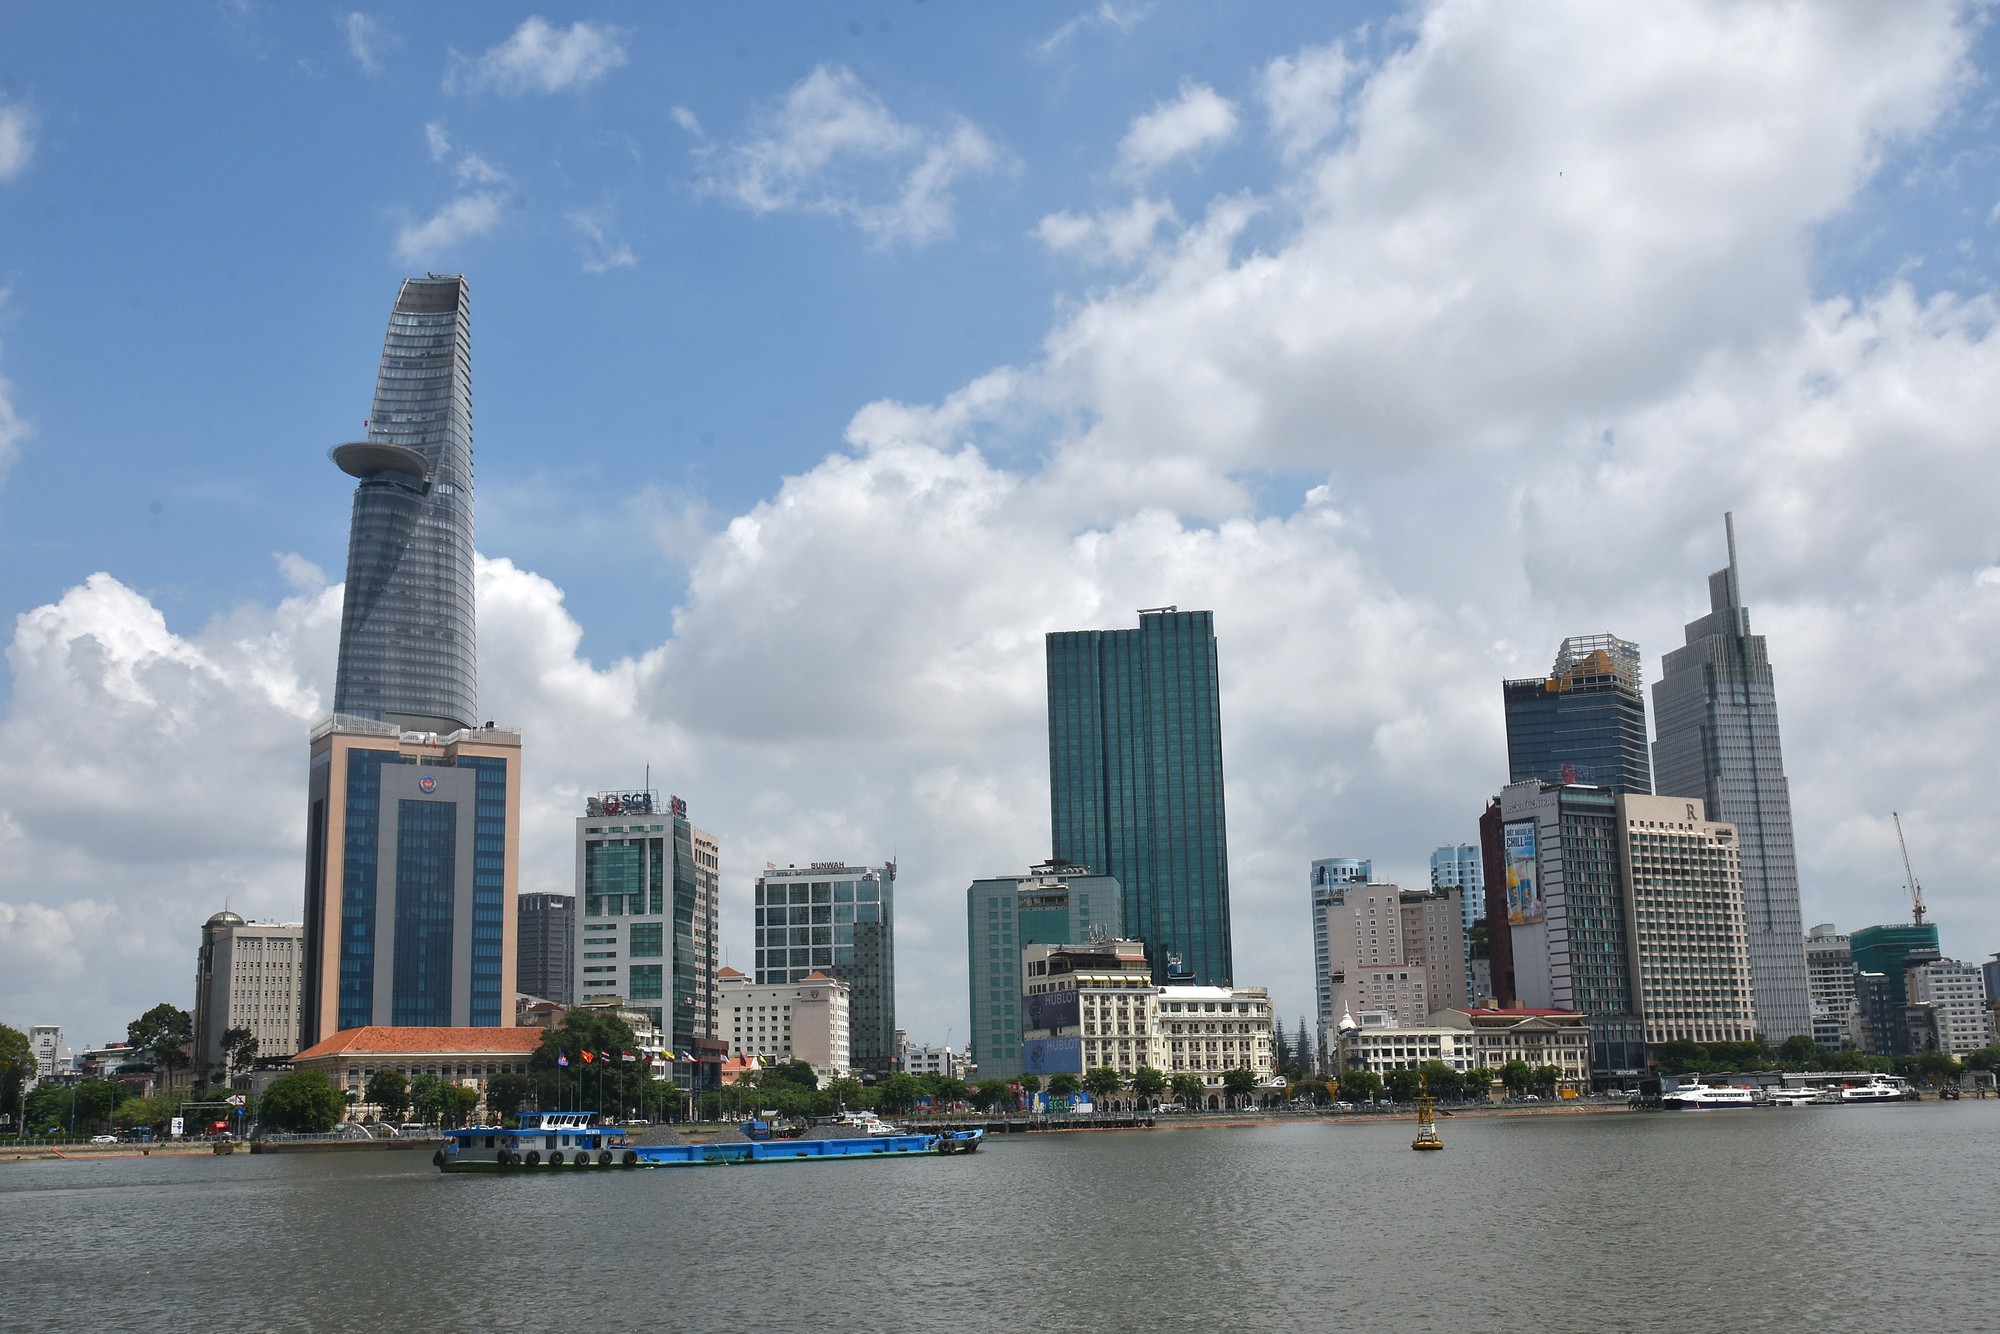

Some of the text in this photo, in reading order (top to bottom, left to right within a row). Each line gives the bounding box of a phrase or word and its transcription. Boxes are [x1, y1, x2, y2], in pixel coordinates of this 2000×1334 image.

[622, 793, 652, 807] SCB
[1504, 797, 1556, 814] LIBERTY CENTRAL
[1686, 803, 1698, 820] R
[810, 861, 845, 870] SUNWAH
[1045, 991, 1078, 1006] HUBLOT
[1046, 1038, 1079, 1052] HUBLOT
